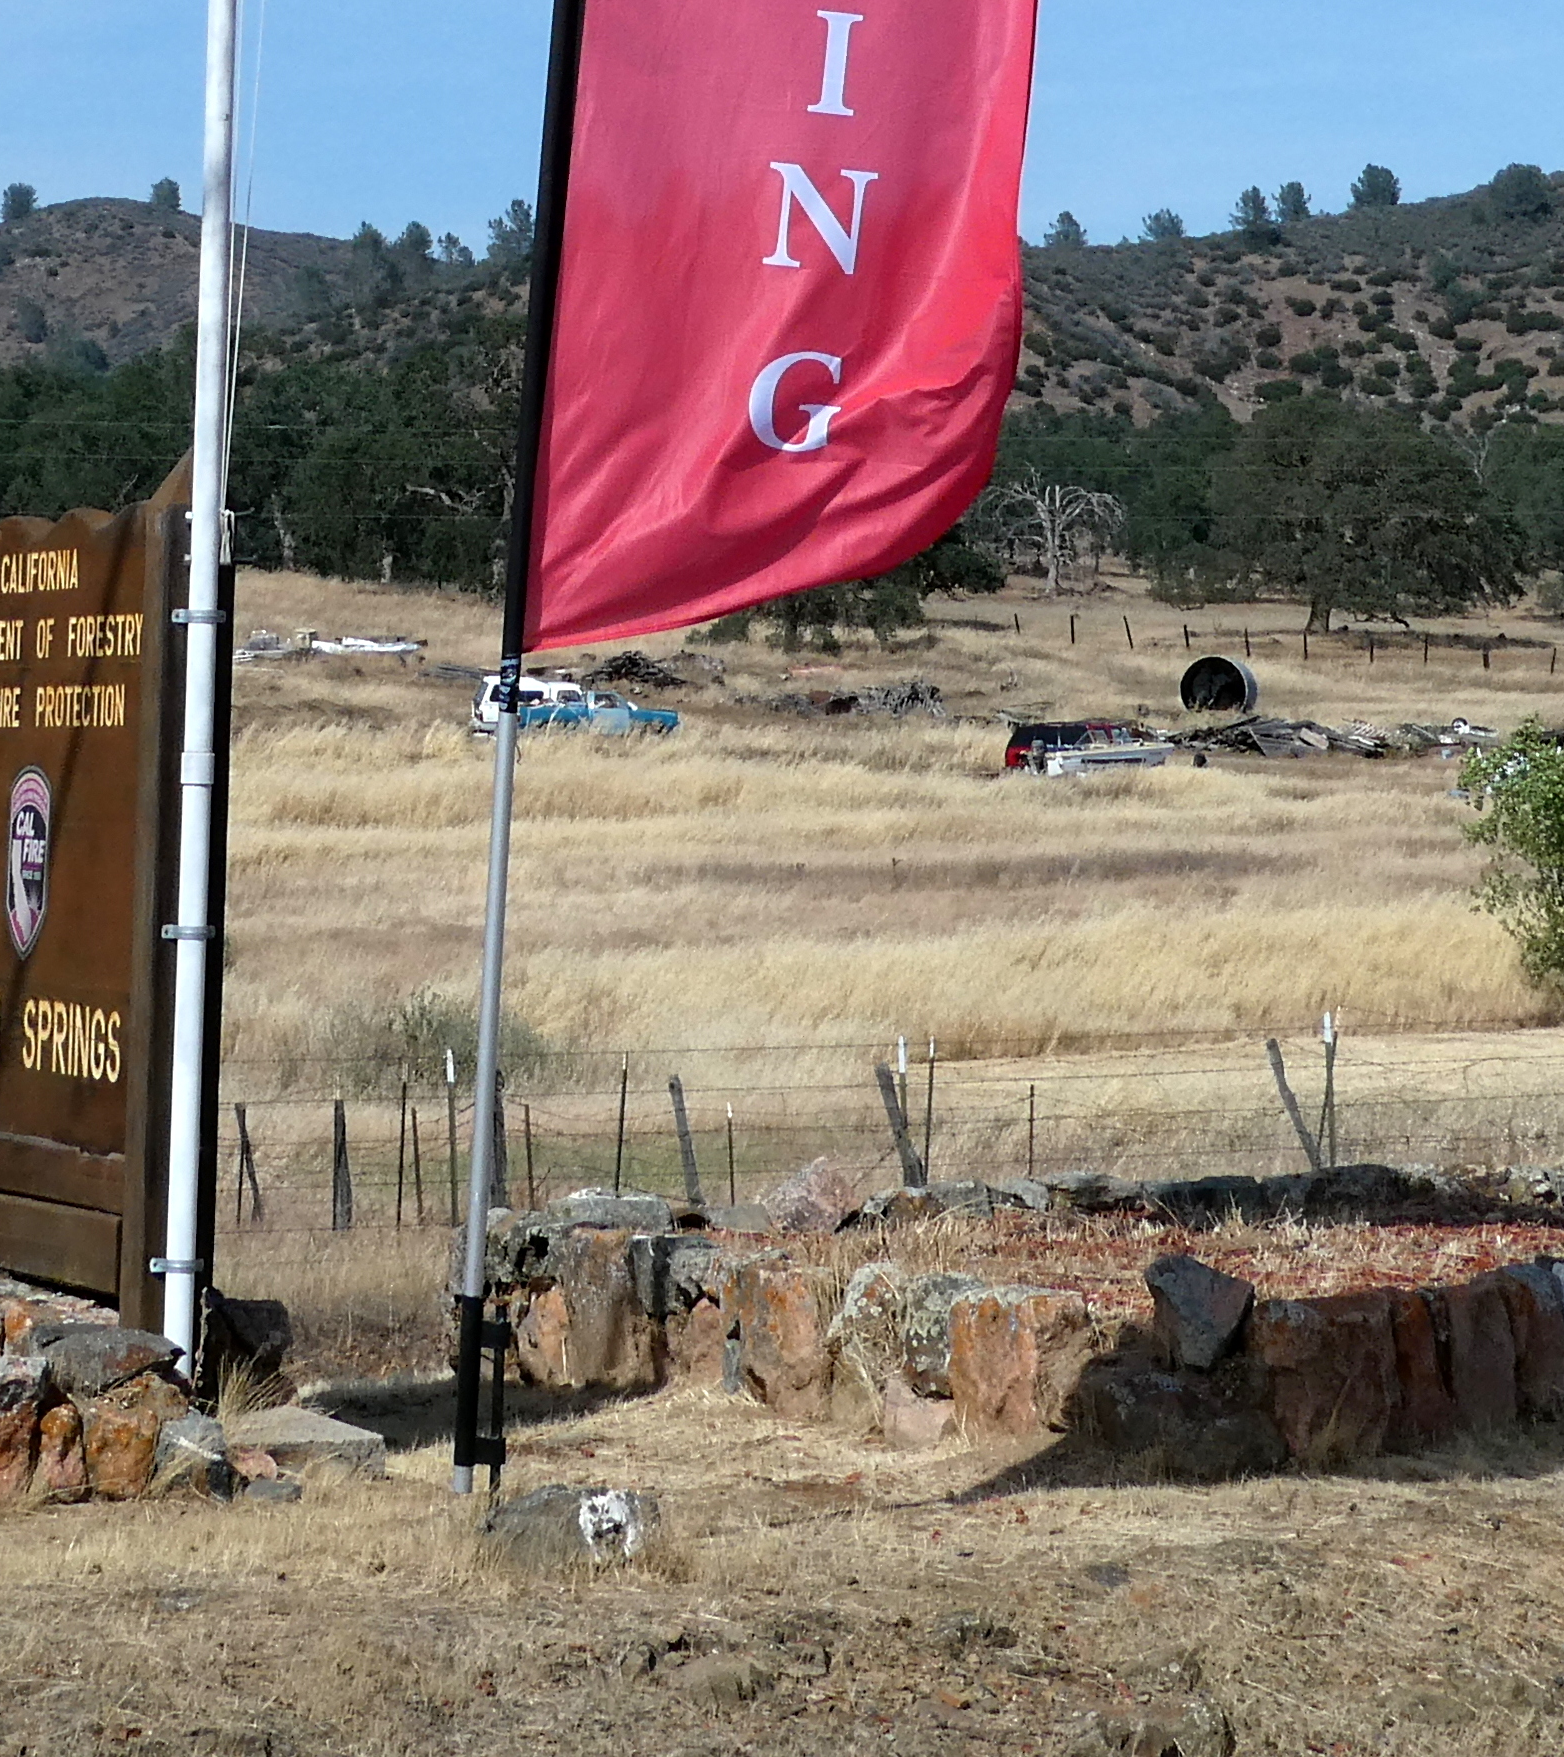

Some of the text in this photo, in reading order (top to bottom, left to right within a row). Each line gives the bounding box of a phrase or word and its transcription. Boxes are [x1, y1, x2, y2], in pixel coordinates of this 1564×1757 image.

[0, 548, 79, 594] CALIFORNIA
[36, 618, 55, 659] OF
[67, 613, 144, 657] FORESTRY
[35, 683, 125, 728] PROTECTION
[16, 810, 35, 837] CAL
[22, 838, 46, 864] FIRE
[22, 998, 121, 1083] SPRINGS
